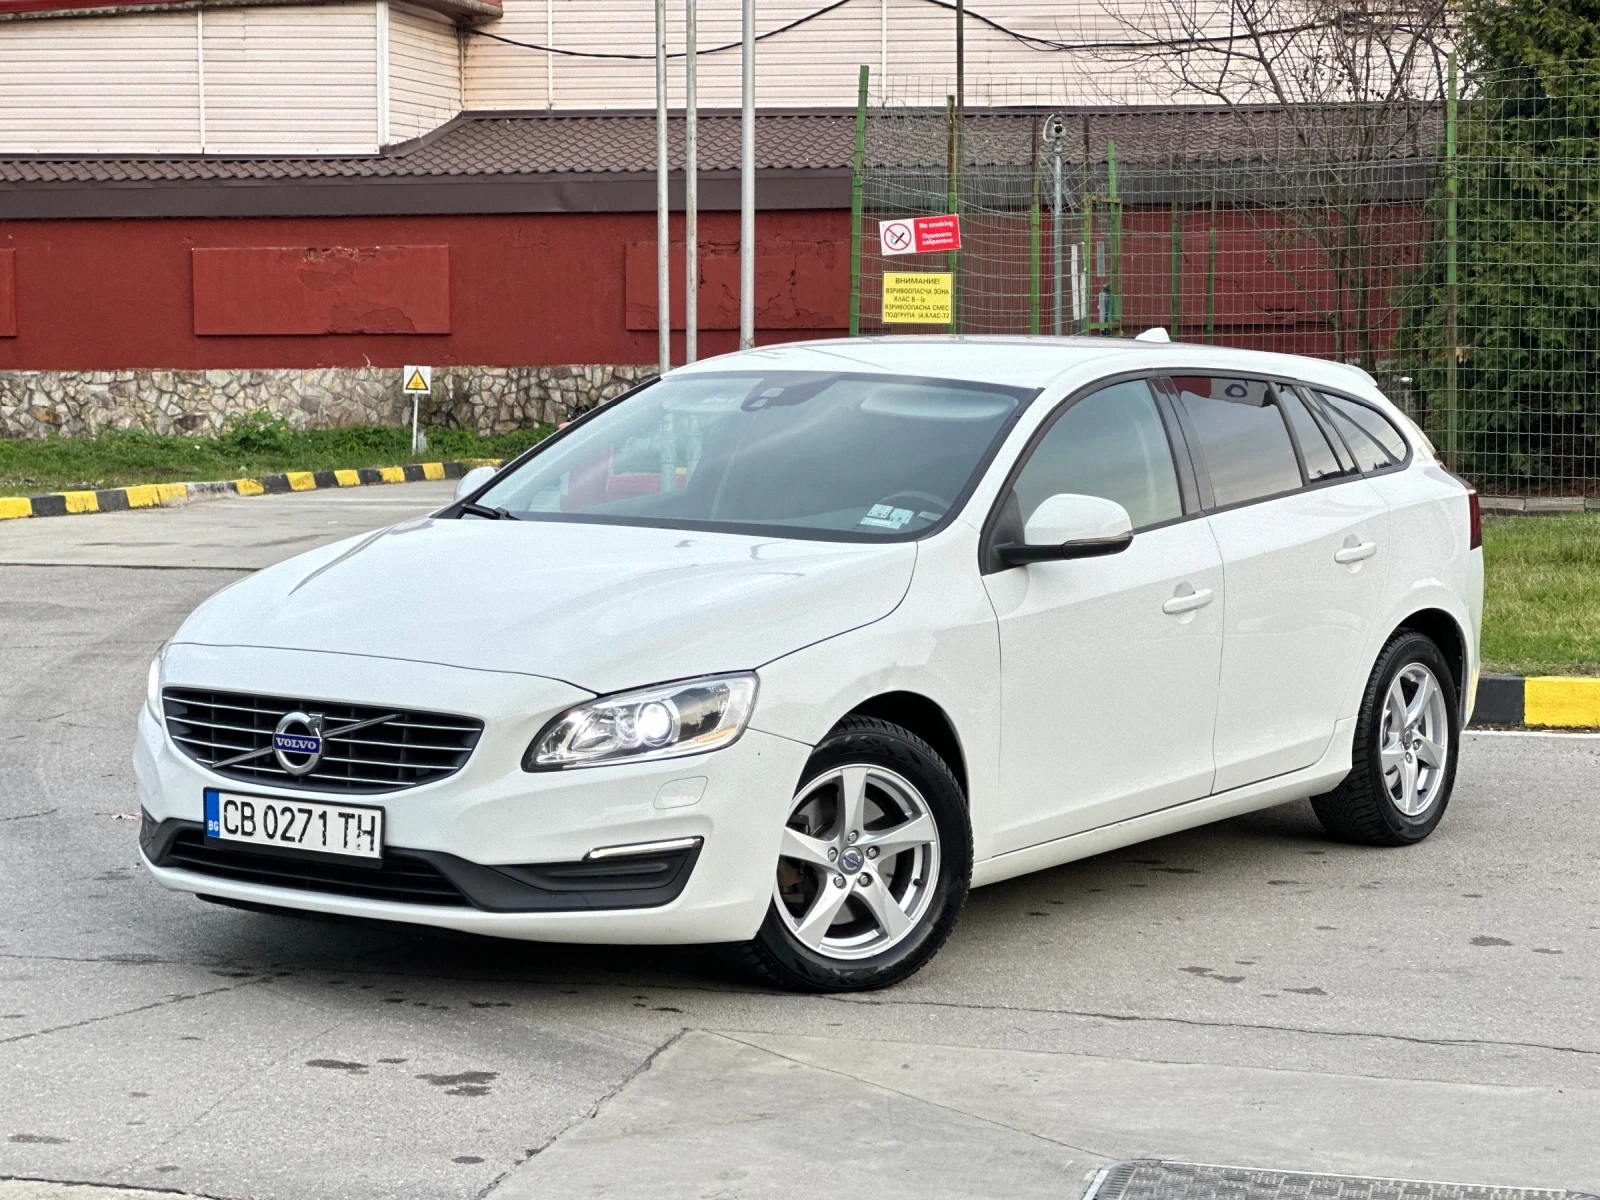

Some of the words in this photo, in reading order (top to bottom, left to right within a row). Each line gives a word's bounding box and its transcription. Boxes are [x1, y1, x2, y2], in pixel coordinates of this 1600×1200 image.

[929, 220, 954, 228] smoking
[275, 737, 317, 750] VOLVO
[208, 819, 219, 831] BG
[223, 799, 257, 837] CB
[263, 804, 328, 847] 0271
[337, 811, 376, 851] TH
